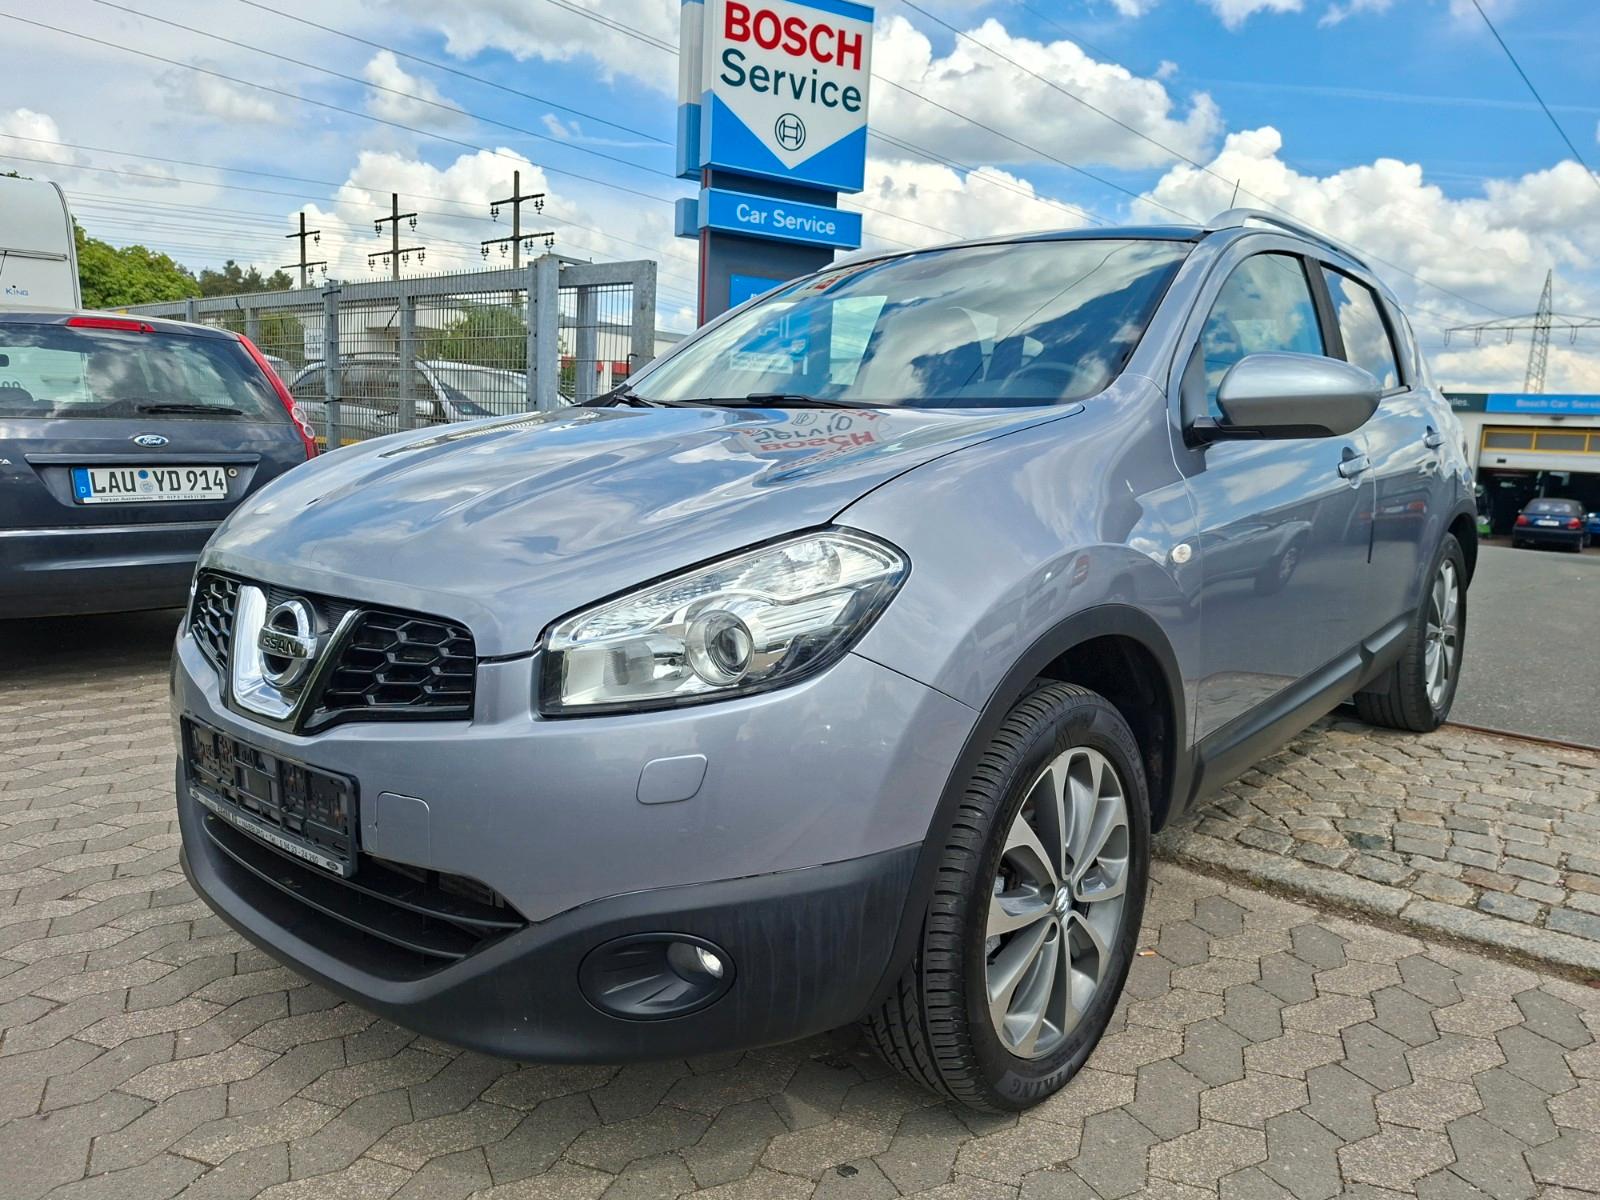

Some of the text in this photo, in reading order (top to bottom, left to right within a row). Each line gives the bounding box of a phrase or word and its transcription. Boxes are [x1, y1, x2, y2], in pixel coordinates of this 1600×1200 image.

[724, 0, 862, 70] BOSCH
[720, 48, 862, 112] Service
[736, 203, 836, 235] Car Service
[80, 486, 87, 495] D
[91, 470, 225, 493] LAU YD 914
